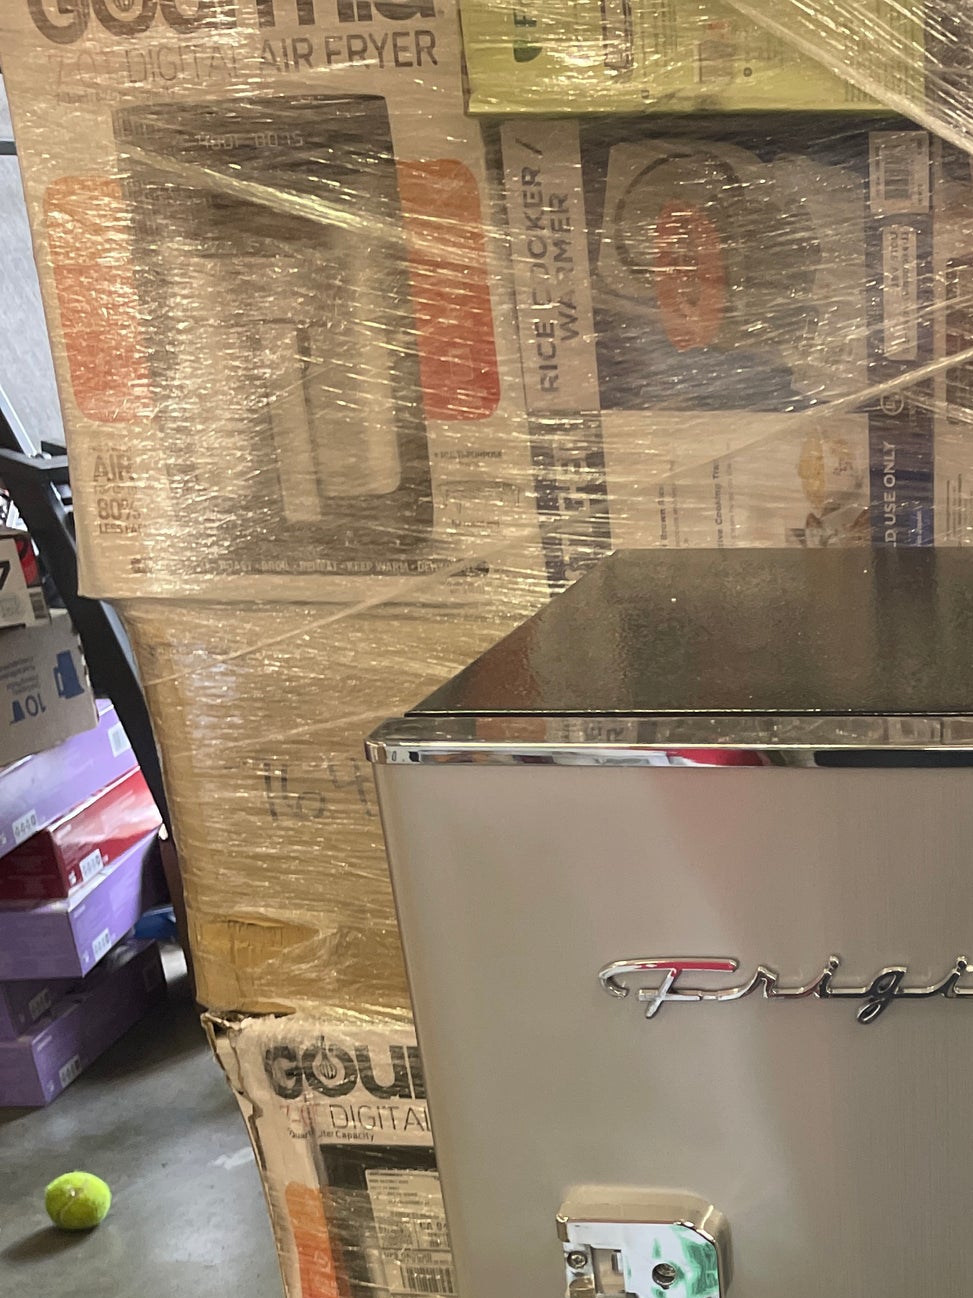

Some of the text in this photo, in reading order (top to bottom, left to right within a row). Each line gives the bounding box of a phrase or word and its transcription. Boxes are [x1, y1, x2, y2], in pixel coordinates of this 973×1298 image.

[259, 38, 314, 73] AIR
[325, 30, 438, 68] FRYER
[535, 320, 559, 393] RICE
[882, 440, 896, 489] ONLY
[883, 490, 897, 527] USE
[335, 1130, 375, 1142] Capacity
